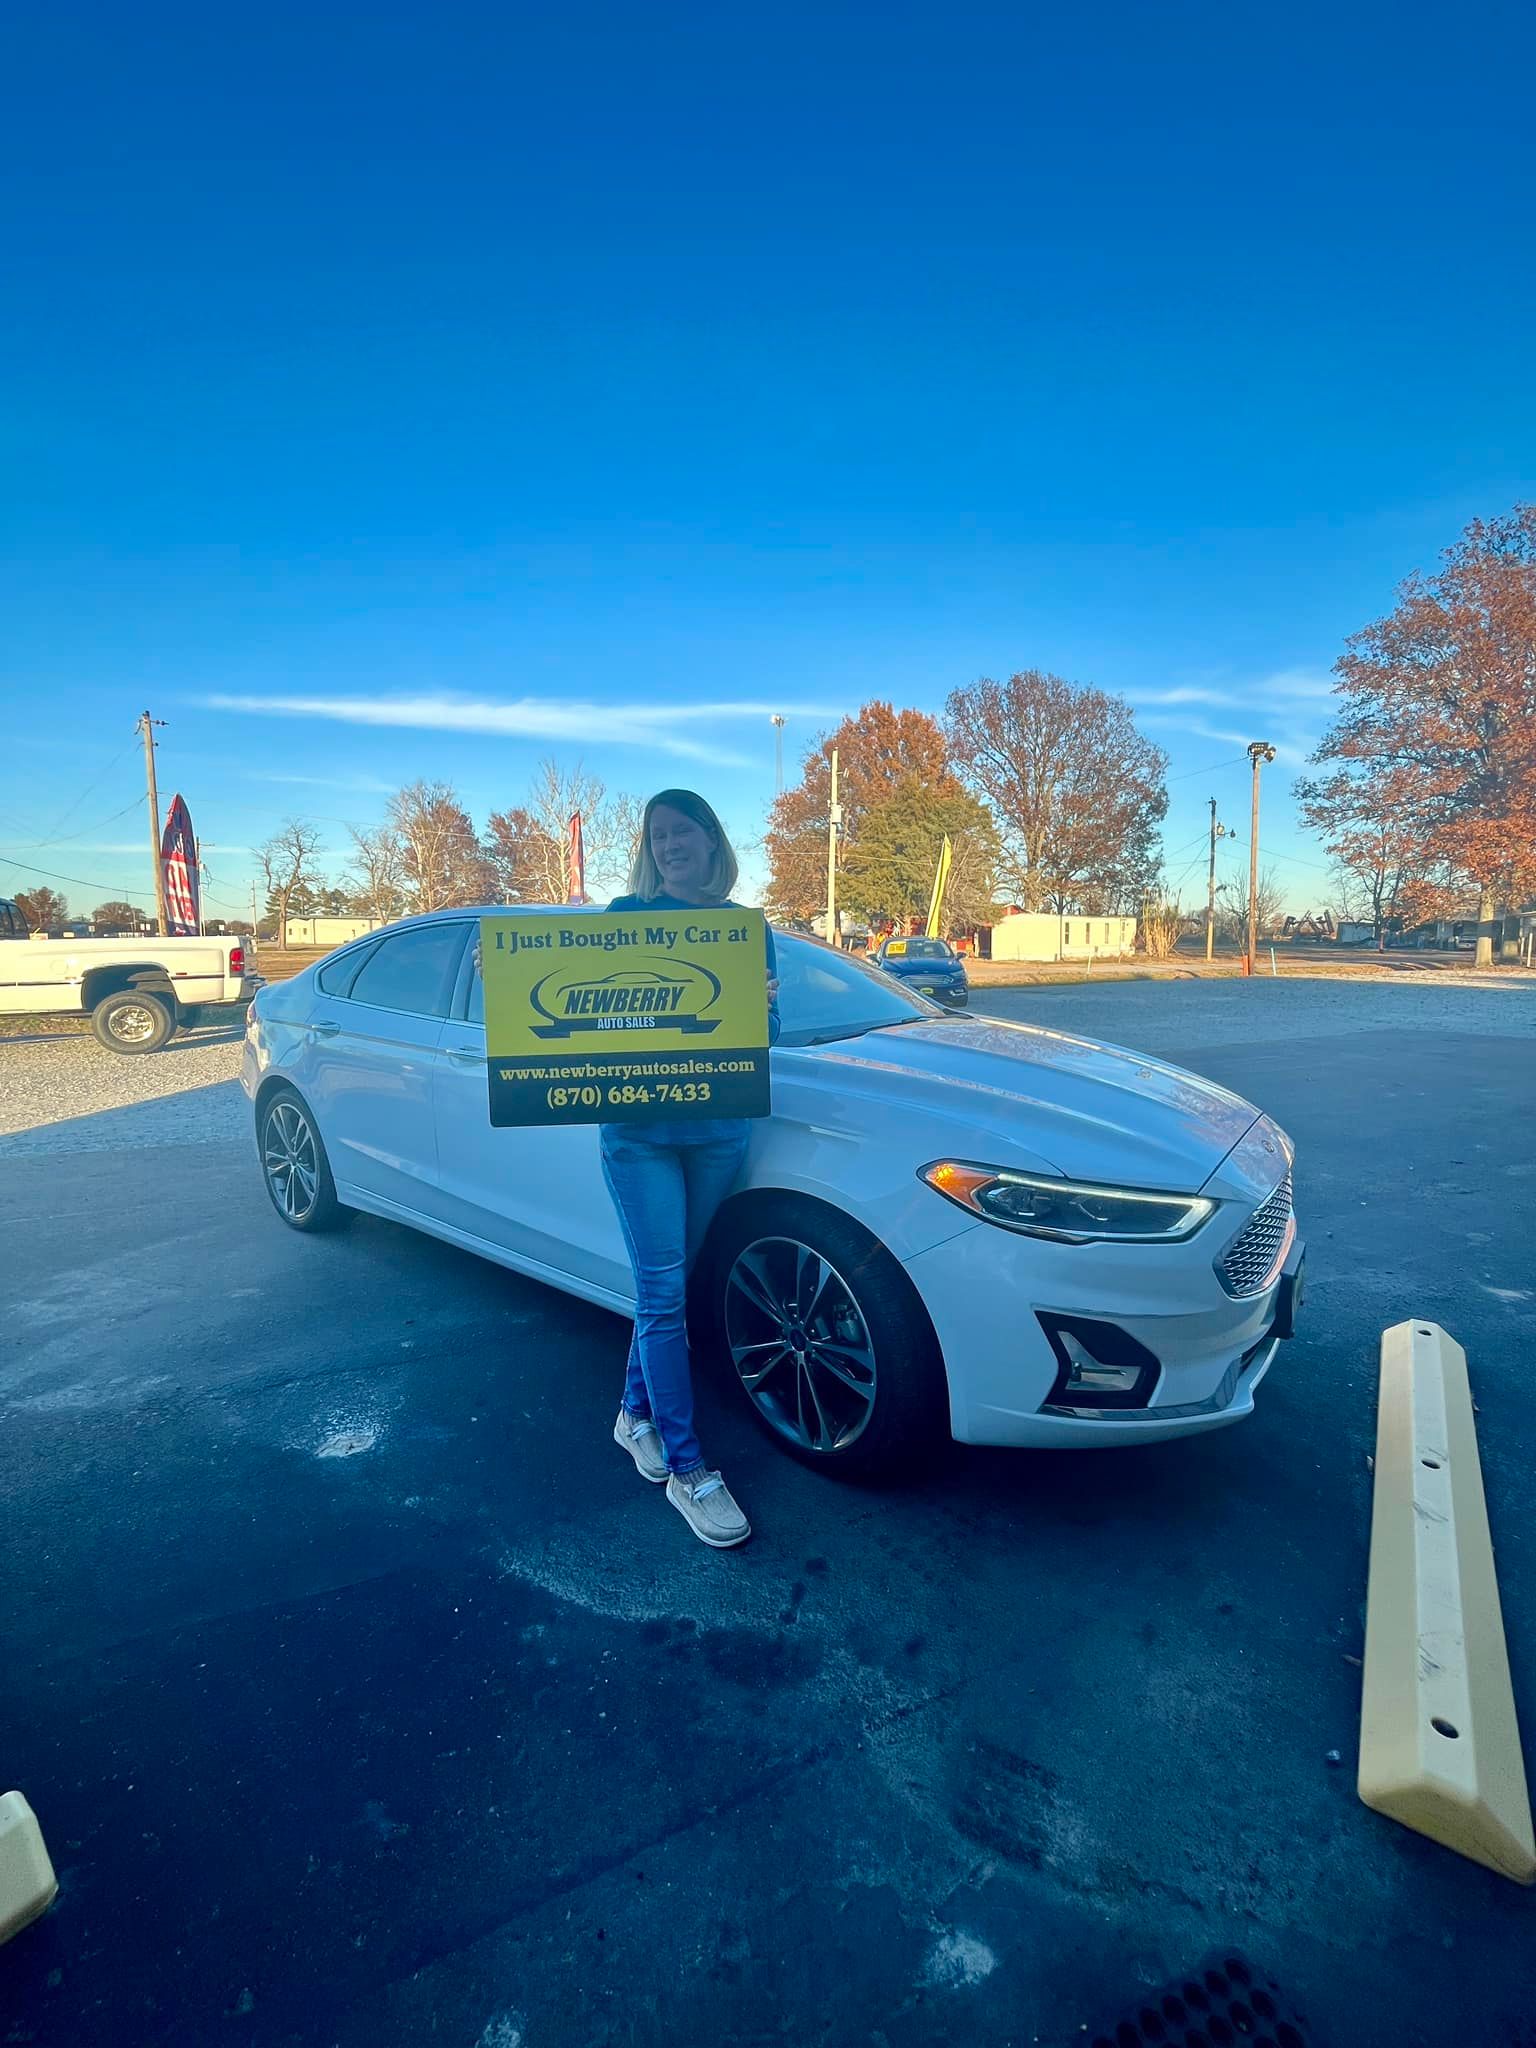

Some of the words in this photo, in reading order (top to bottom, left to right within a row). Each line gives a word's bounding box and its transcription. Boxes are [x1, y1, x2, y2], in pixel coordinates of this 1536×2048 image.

[496, 932, 504, 949] I
[510, 931, 552, 954] Just
[559, 928, 639, 951] Bought
[645, 927, 678, 949] My
[684, 925, 721, 943] Car
[728, 926, 748, 942] at
[564, 986, 685, 1014] NEWBERRY
[597, 1017, 623, 1029] AUTO
[626, 1016, 655, 1028] SALES
[500, 1060, 755, 1081] www.newberryautosales.com
[547, 1087, 601, 1109] (870)
[608, 1083, 711, 1104] 684-7433
